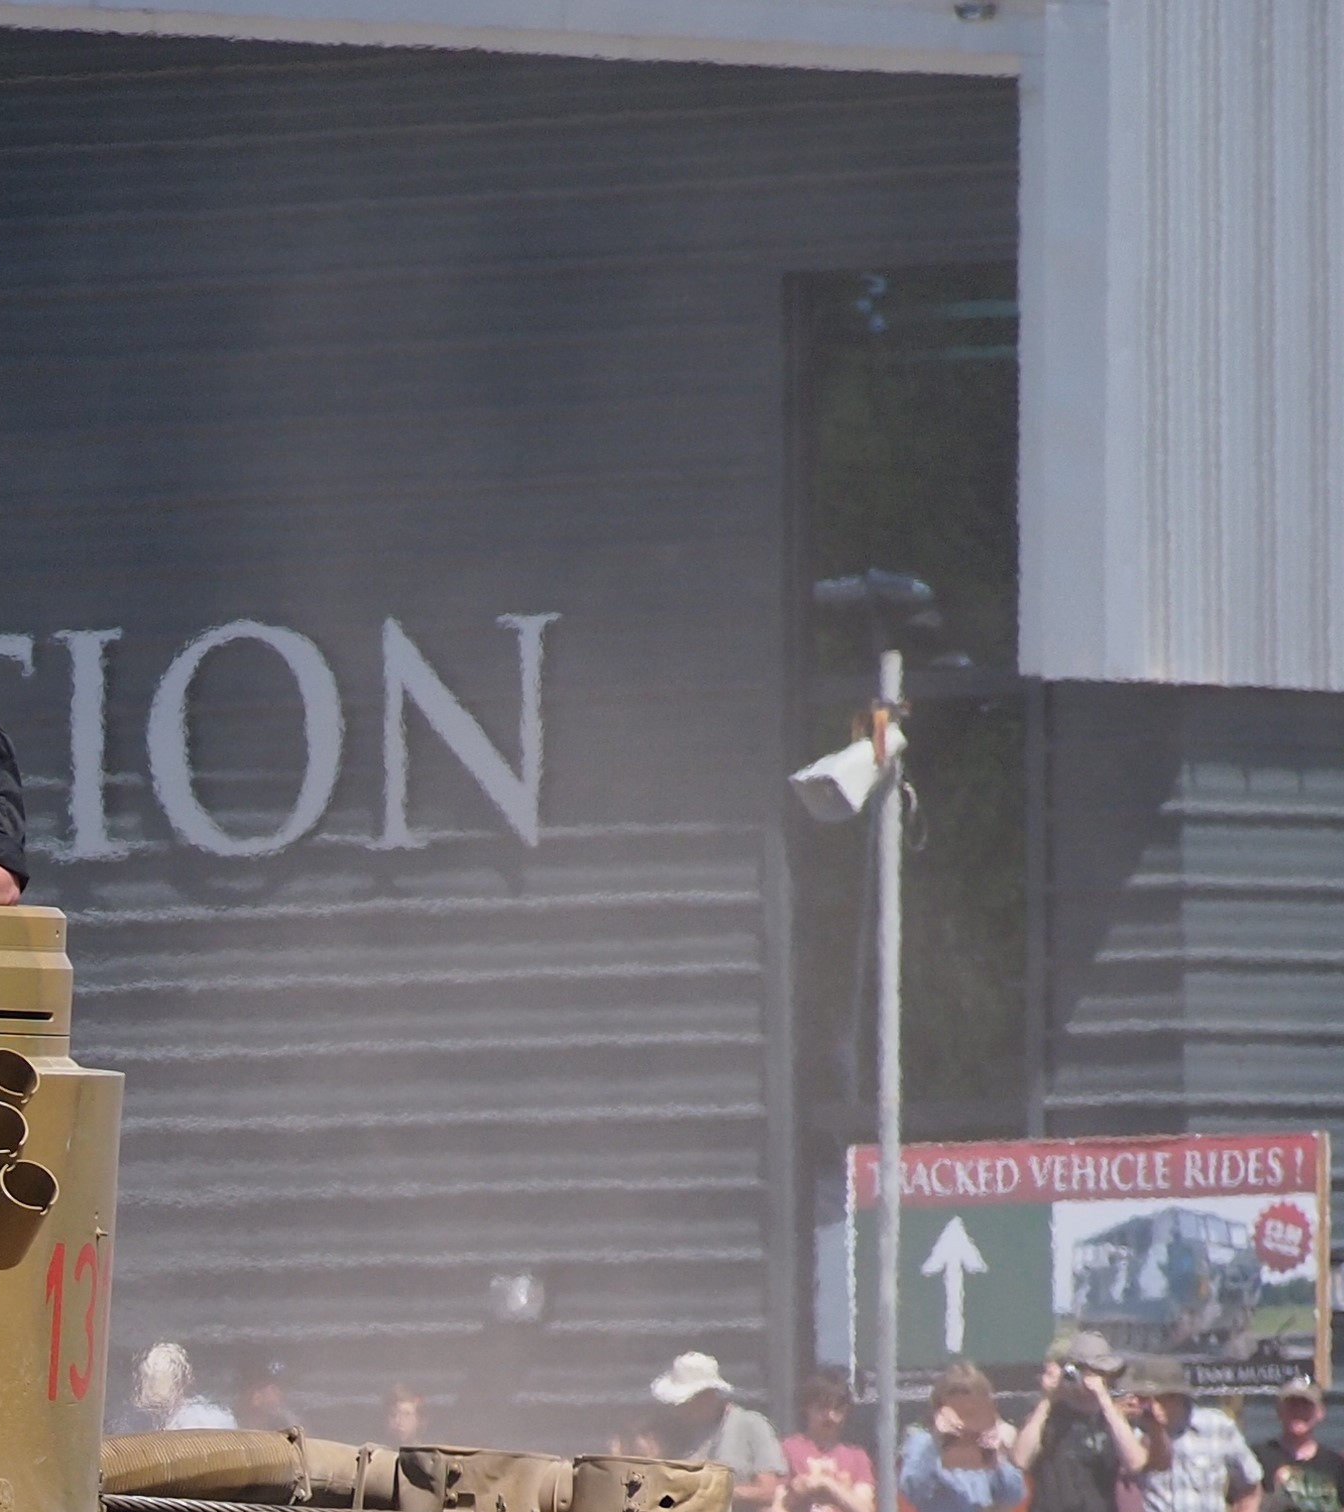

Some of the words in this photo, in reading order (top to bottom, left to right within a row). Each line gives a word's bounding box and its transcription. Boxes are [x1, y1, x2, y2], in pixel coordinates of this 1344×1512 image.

[1028, 1151, 1172, 1191] VEHICLE
[1184, 1147, 1284, 1187] RIDES
[45, 1242, 110, 1401] 13
